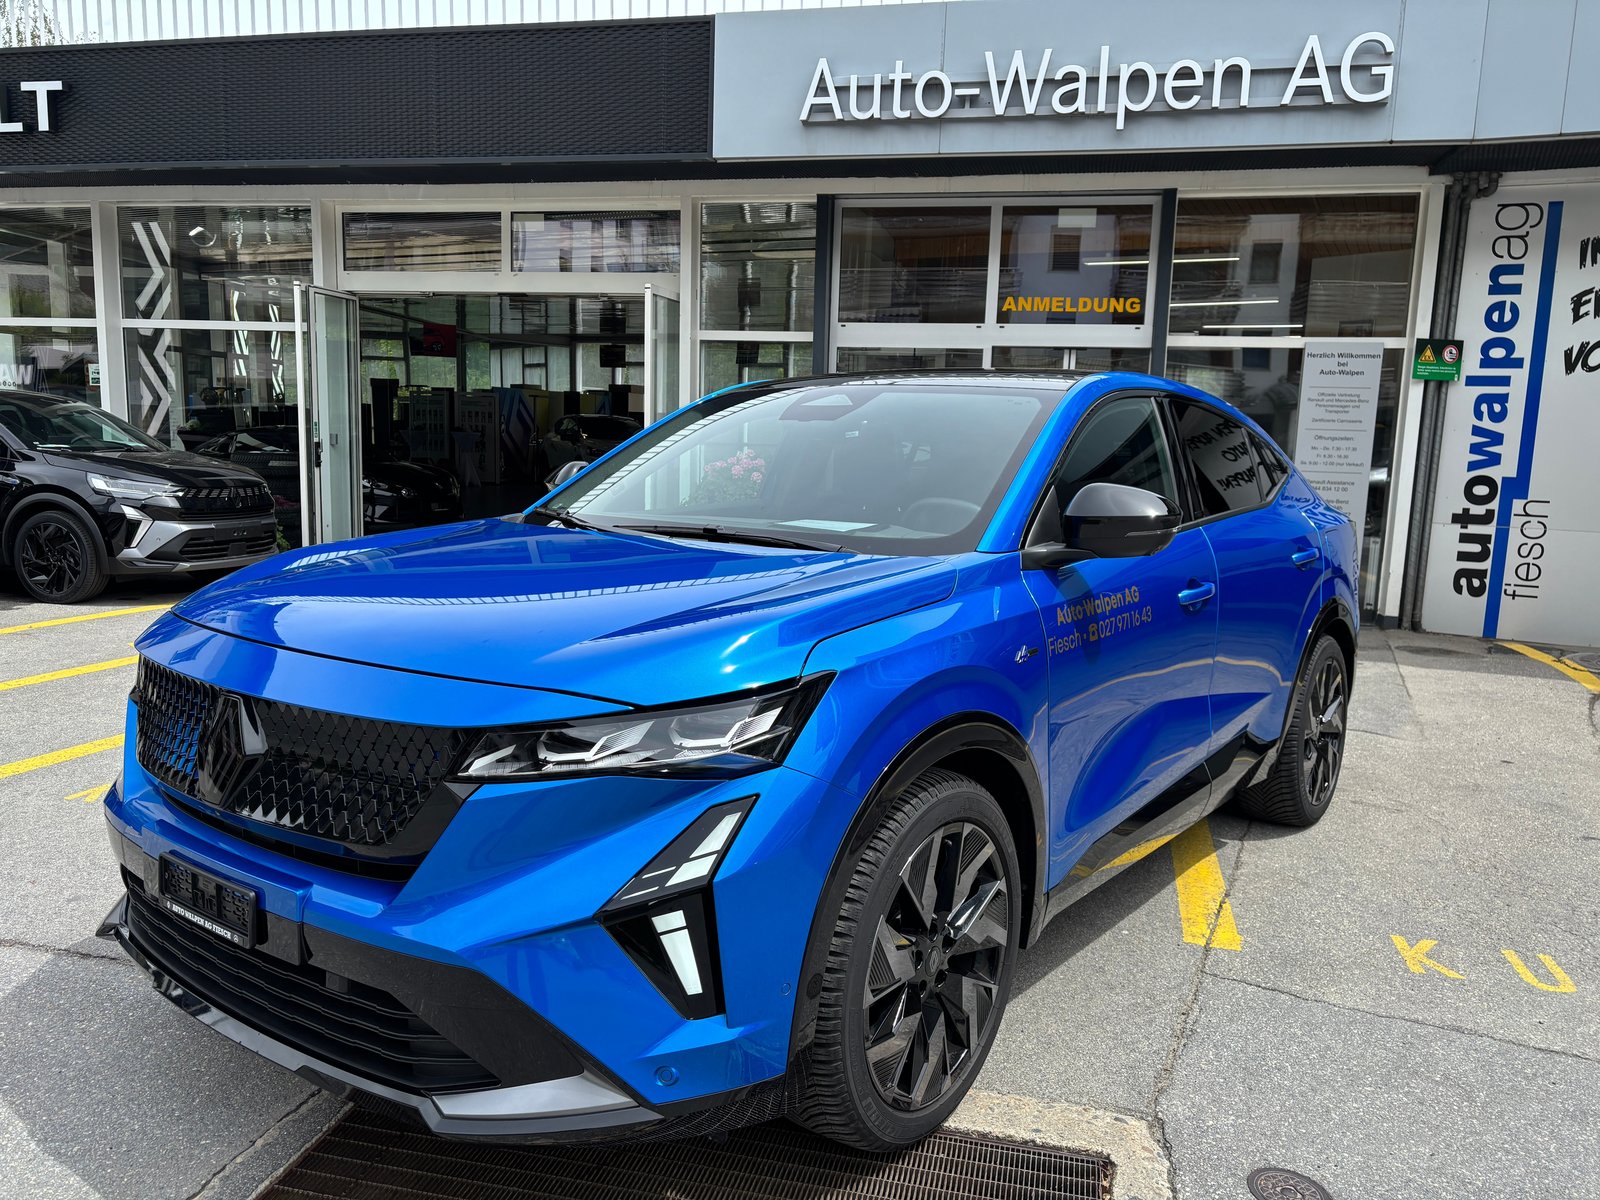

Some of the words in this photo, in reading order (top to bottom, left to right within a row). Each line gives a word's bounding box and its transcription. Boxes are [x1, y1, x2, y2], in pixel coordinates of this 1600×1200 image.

[799, 45, 1252, 130] Auto-Walpen
[1280, 31, 1395, 105] AG
[1001, 296, 1141, 313] ANMELDUNG
[1337, 352, 1381, 360] Willkommen
[1319, 369, 1365, 377] Auto-Walpen
[1503, 499, 1550, 600] fiesch
[1125, 585, 1140, 605] AG
[1048, 628, 1082, 656] Fiesch
[1099, 617, 1115, 638] 027
[1117, 611, 1131, 632] 971
[1131, 609, 1141, 627] 16
[1141, 606, 1152, 623] 43
[184, 909, 205, 927] WALPEN
[212, 924, 232, 939] FIESCH
